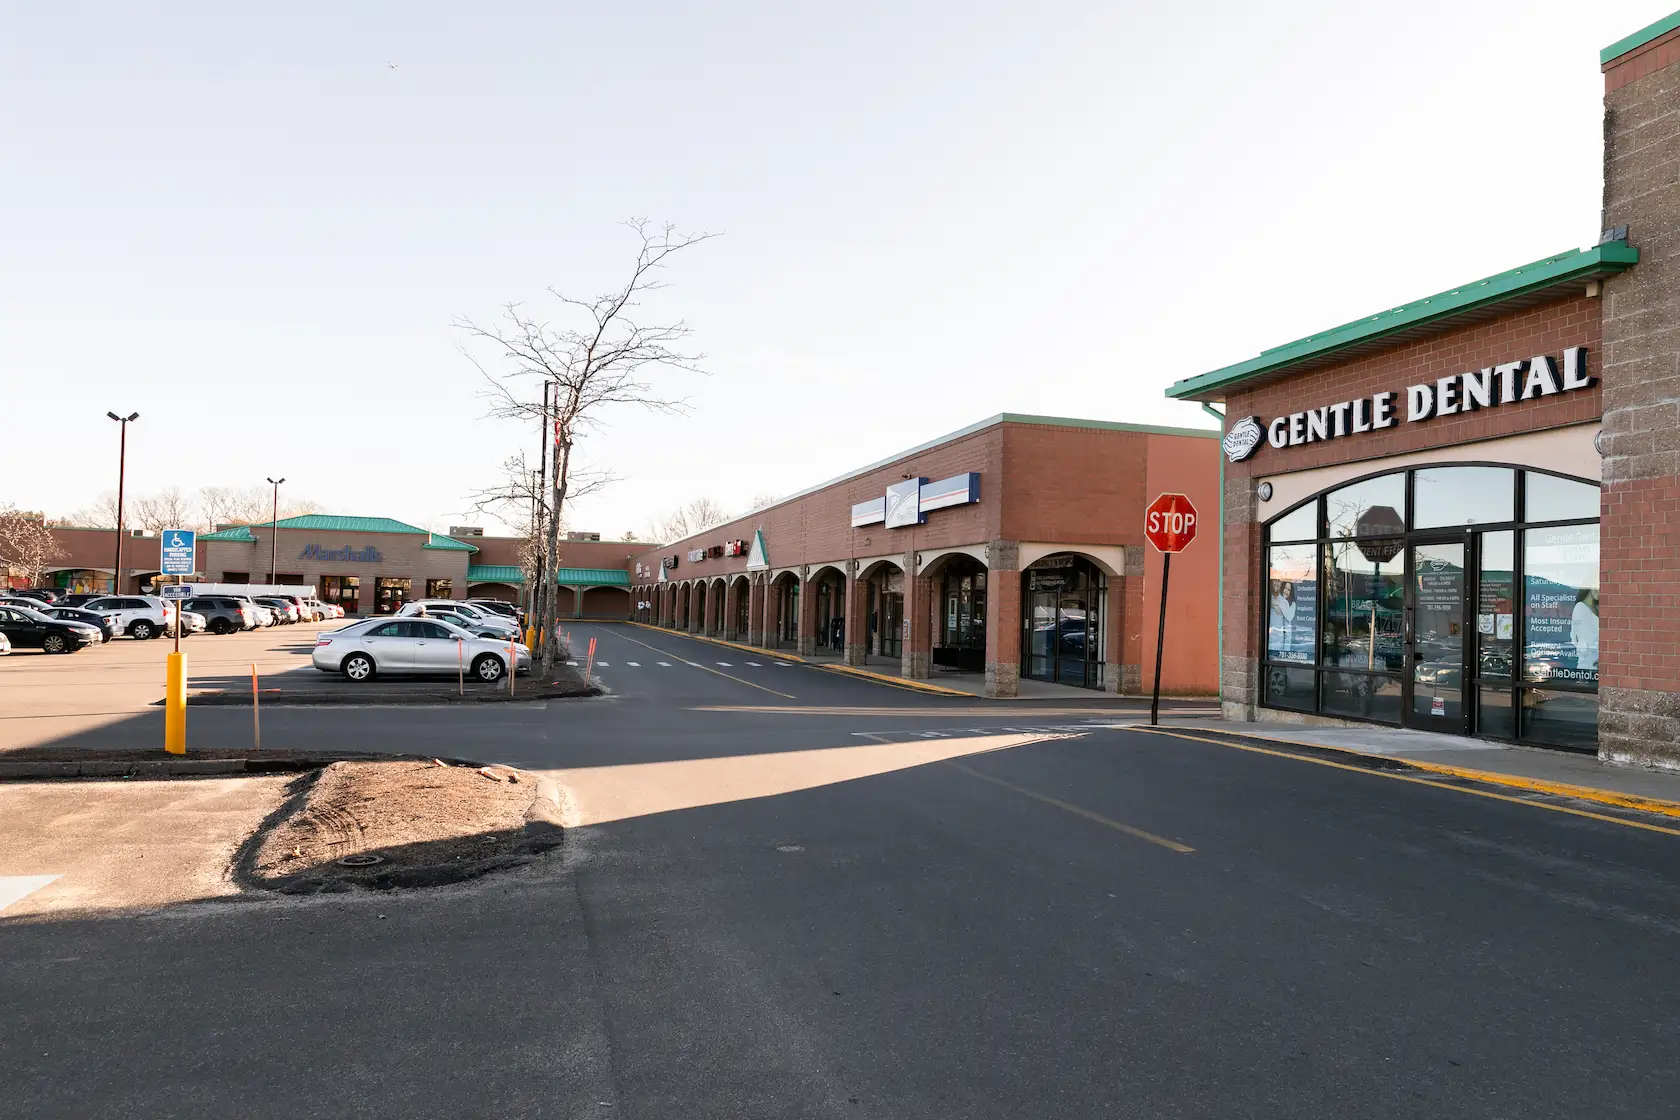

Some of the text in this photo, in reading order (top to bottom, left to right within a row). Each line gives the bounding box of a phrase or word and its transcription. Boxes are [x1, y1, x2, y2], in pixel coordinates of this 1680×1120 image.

[1268, 347, 1595, 449] GENTLE DENTAL
[1234, 430, 1250, 439] GENTLE
[1233, 439, 1249, 447] DENTAL
[1148, 511, 1195, 535] STOP
[296, 543, 383, 562] Marshalls
[1541, 594, 1577, 602] Specialists
[1351, 600, 1379, 609] BRACES
[1530, 625, 1562, 633] Accepted
